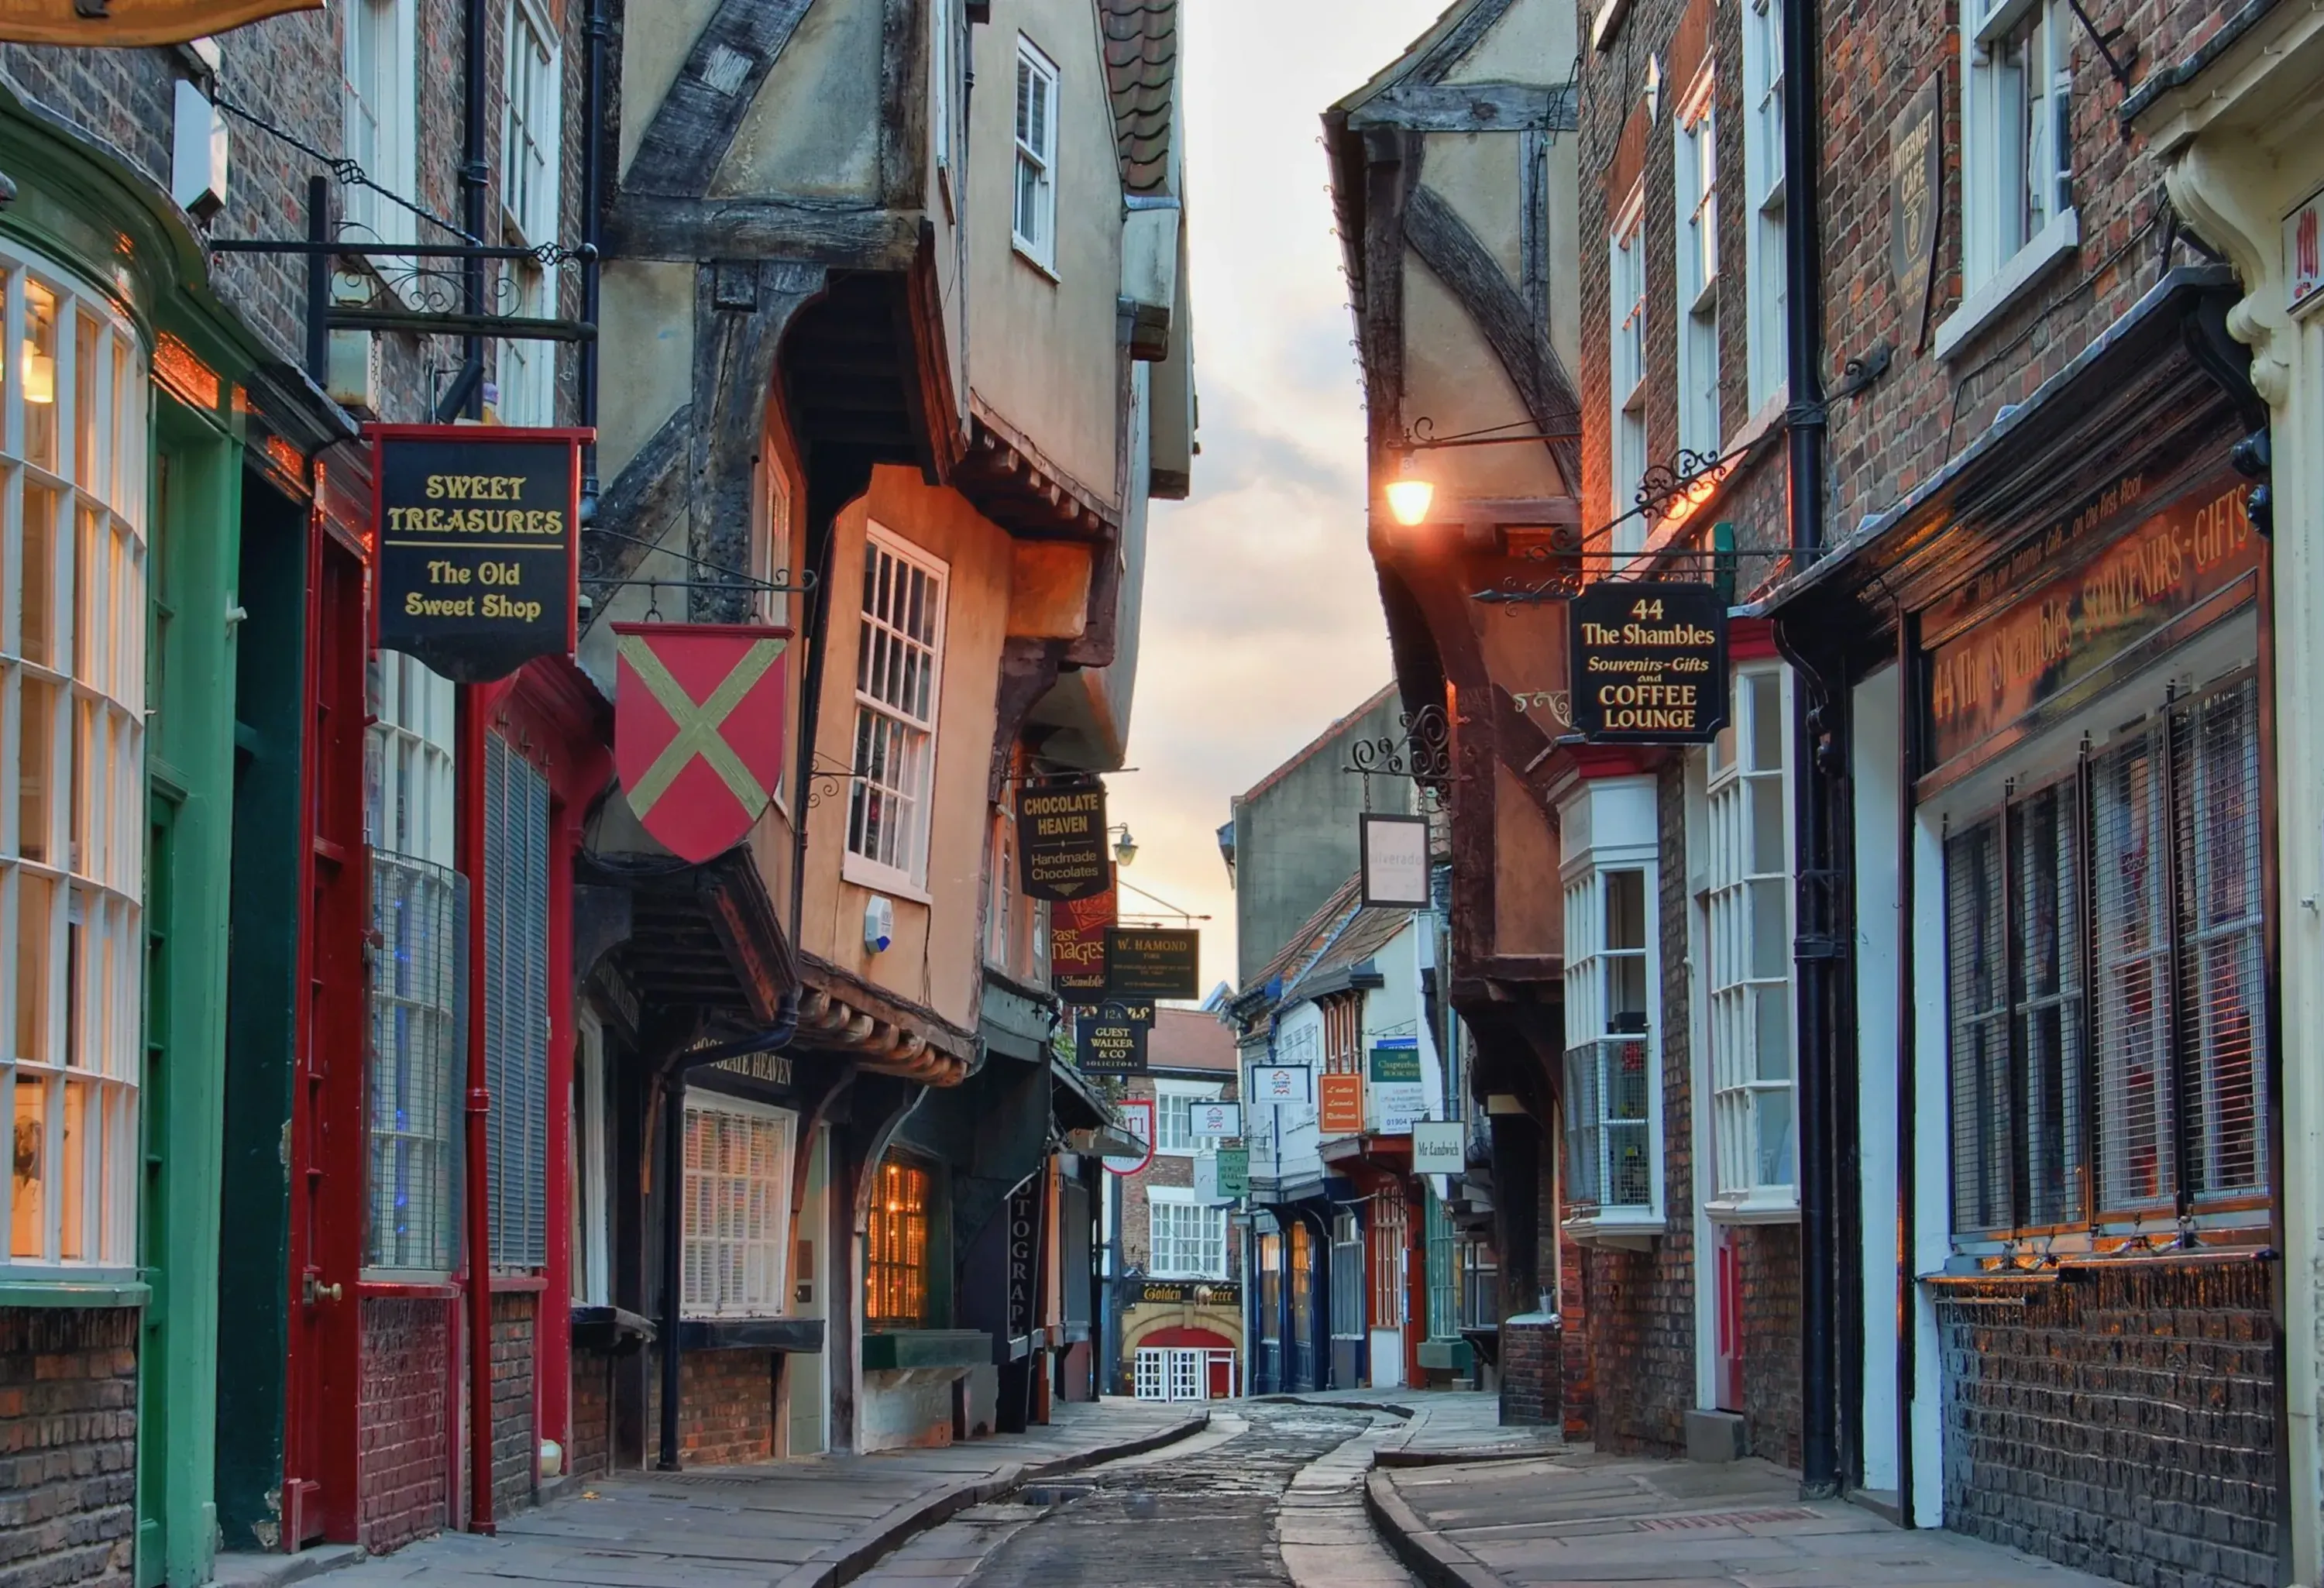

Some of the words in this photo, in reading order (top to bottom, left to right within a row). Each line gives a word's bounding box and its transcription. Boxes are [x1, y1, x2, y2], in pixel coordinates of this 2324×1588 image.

[1893, 108, 1933, 179] INTERNET
[425, 475, 527, 500] SWEET
[387, 507, 563, 534] TREASURES
[428, 560, 471, 584] The
[478, 562, 521, 586] Old
[405, 592, 475, 617] Sweet
[481, 593, 541, 622] Shop
[1631, 599, 1664, 620] 44
[1934, 658, 1954, 720] 44
[1957, 648, 1985, 708] Th
[2083, 525, 2181, 634] SOUVENIRS
[2194, 483, 2247, 566] GIFTS
[1582, 623, 1620, 644] The
[1624, 624, 1715, 644] Shambles
[1638, 674, 1662, 682] and
[1599, 686, 1697, 706] COFFEE
[1605, 710, 1695, 727] LOUNGE
[1024, 794, 1098, 816] CHOCOLATE
[1038, 816, 1088, 835] HEAVEN
[1032, 851, 1097, 866] Handmade
[1032, 867, 1098, 880] Chocolates
[1118, 938, 1131, 950] W.
[1135, 940, 1187, 951] HAMOND
[1061, 975, 1105, 987] Shamble
[1095, 1028, 1130, 1036] GUEST
[1091, 1039, 1134, 1047] WALKER
[1109, 1050, 1126, 1058] CO
[751, 1053, 792, 1085] HEAVEN
[1418, 1141, 1428, 1156] Mr
[1430, 1140, 1459, 1156] Sandwich
[1144, 1287, 1181, 1301] Golden
